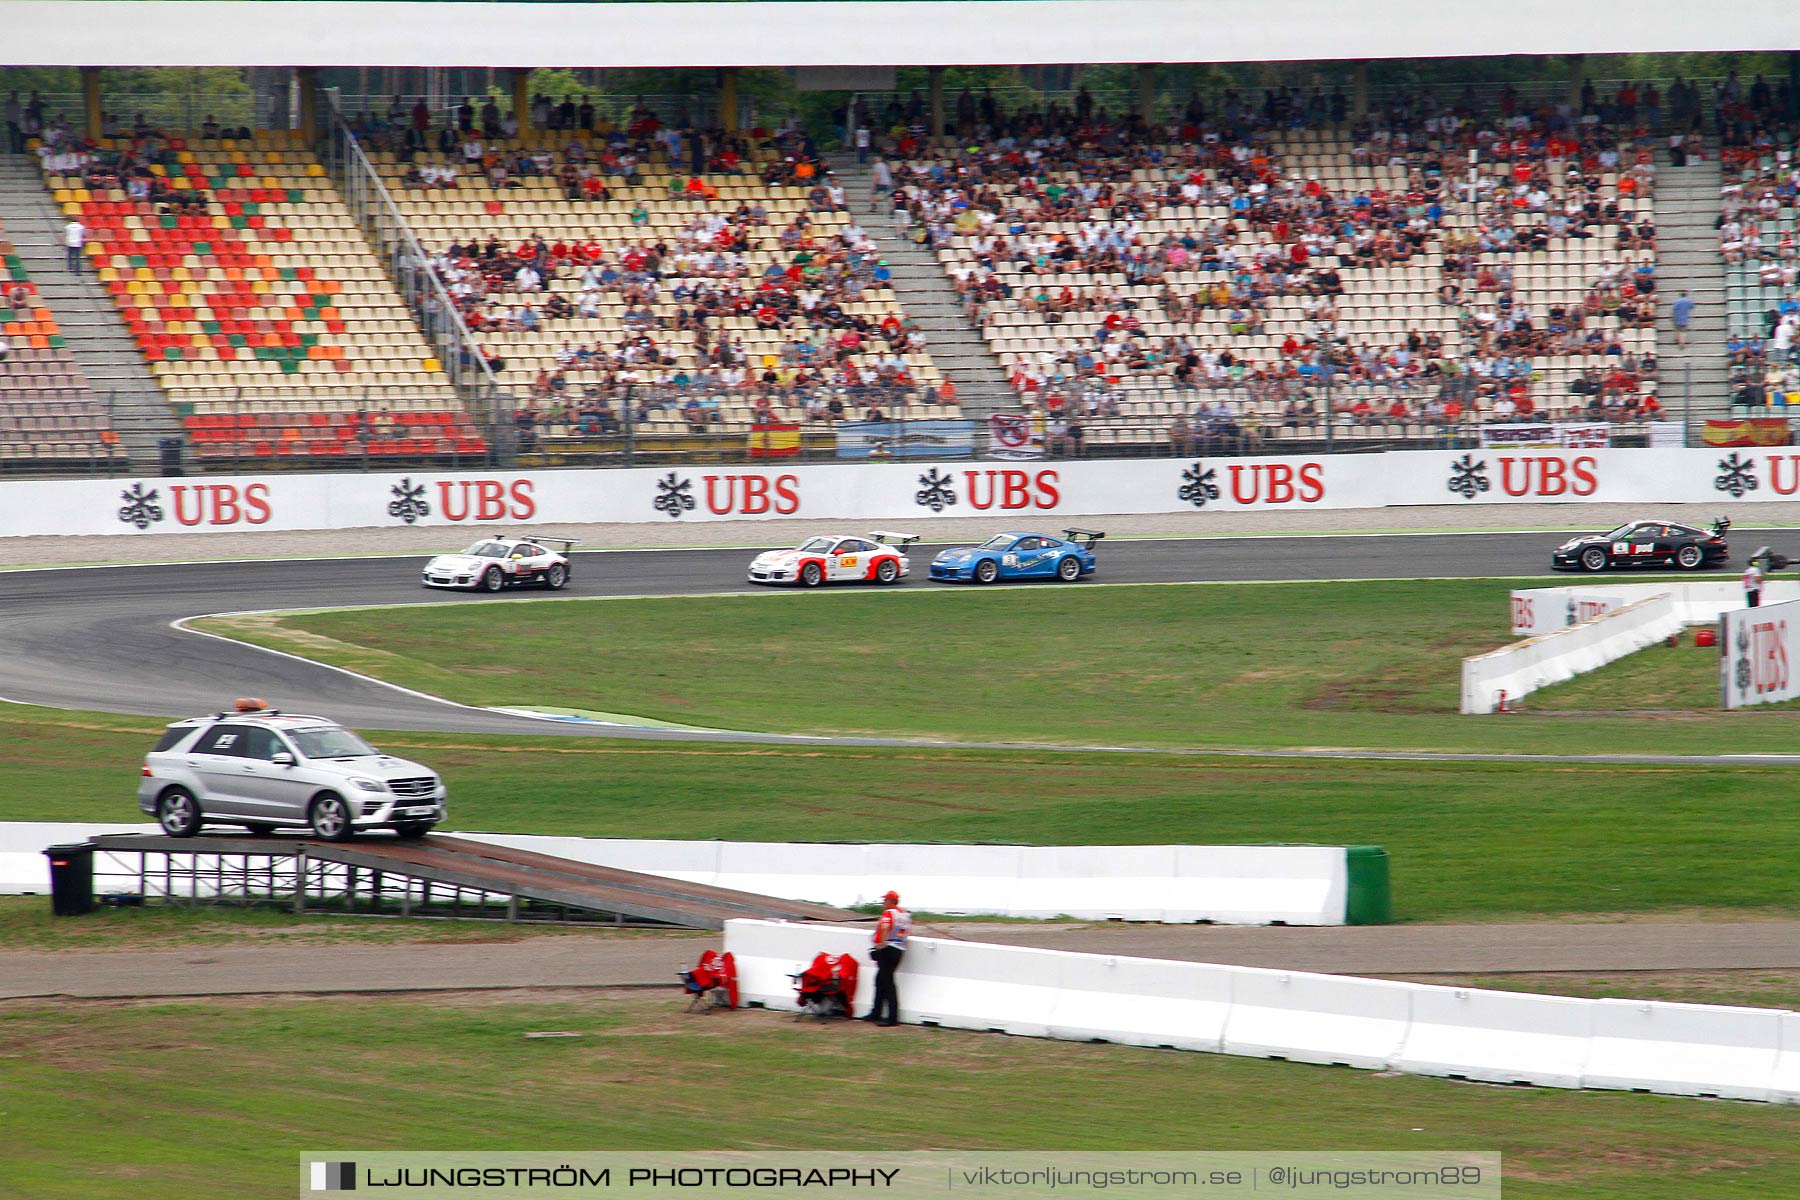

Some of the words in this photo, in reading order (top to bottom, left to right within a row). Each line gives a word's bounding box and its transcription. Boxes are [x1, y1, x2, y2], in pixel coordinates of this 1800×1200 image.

[703, 474, 800, 515] UBS
[963, 469, 1060, 509] UBS
[1227, 462, 1325, 504] UBS
[1497, 456, 1598, 496] UBS
[169, 483, 271, 526] UBS
[436, 479, 535, 521] UBS
[1752, 620, 1790, 694] UBS
